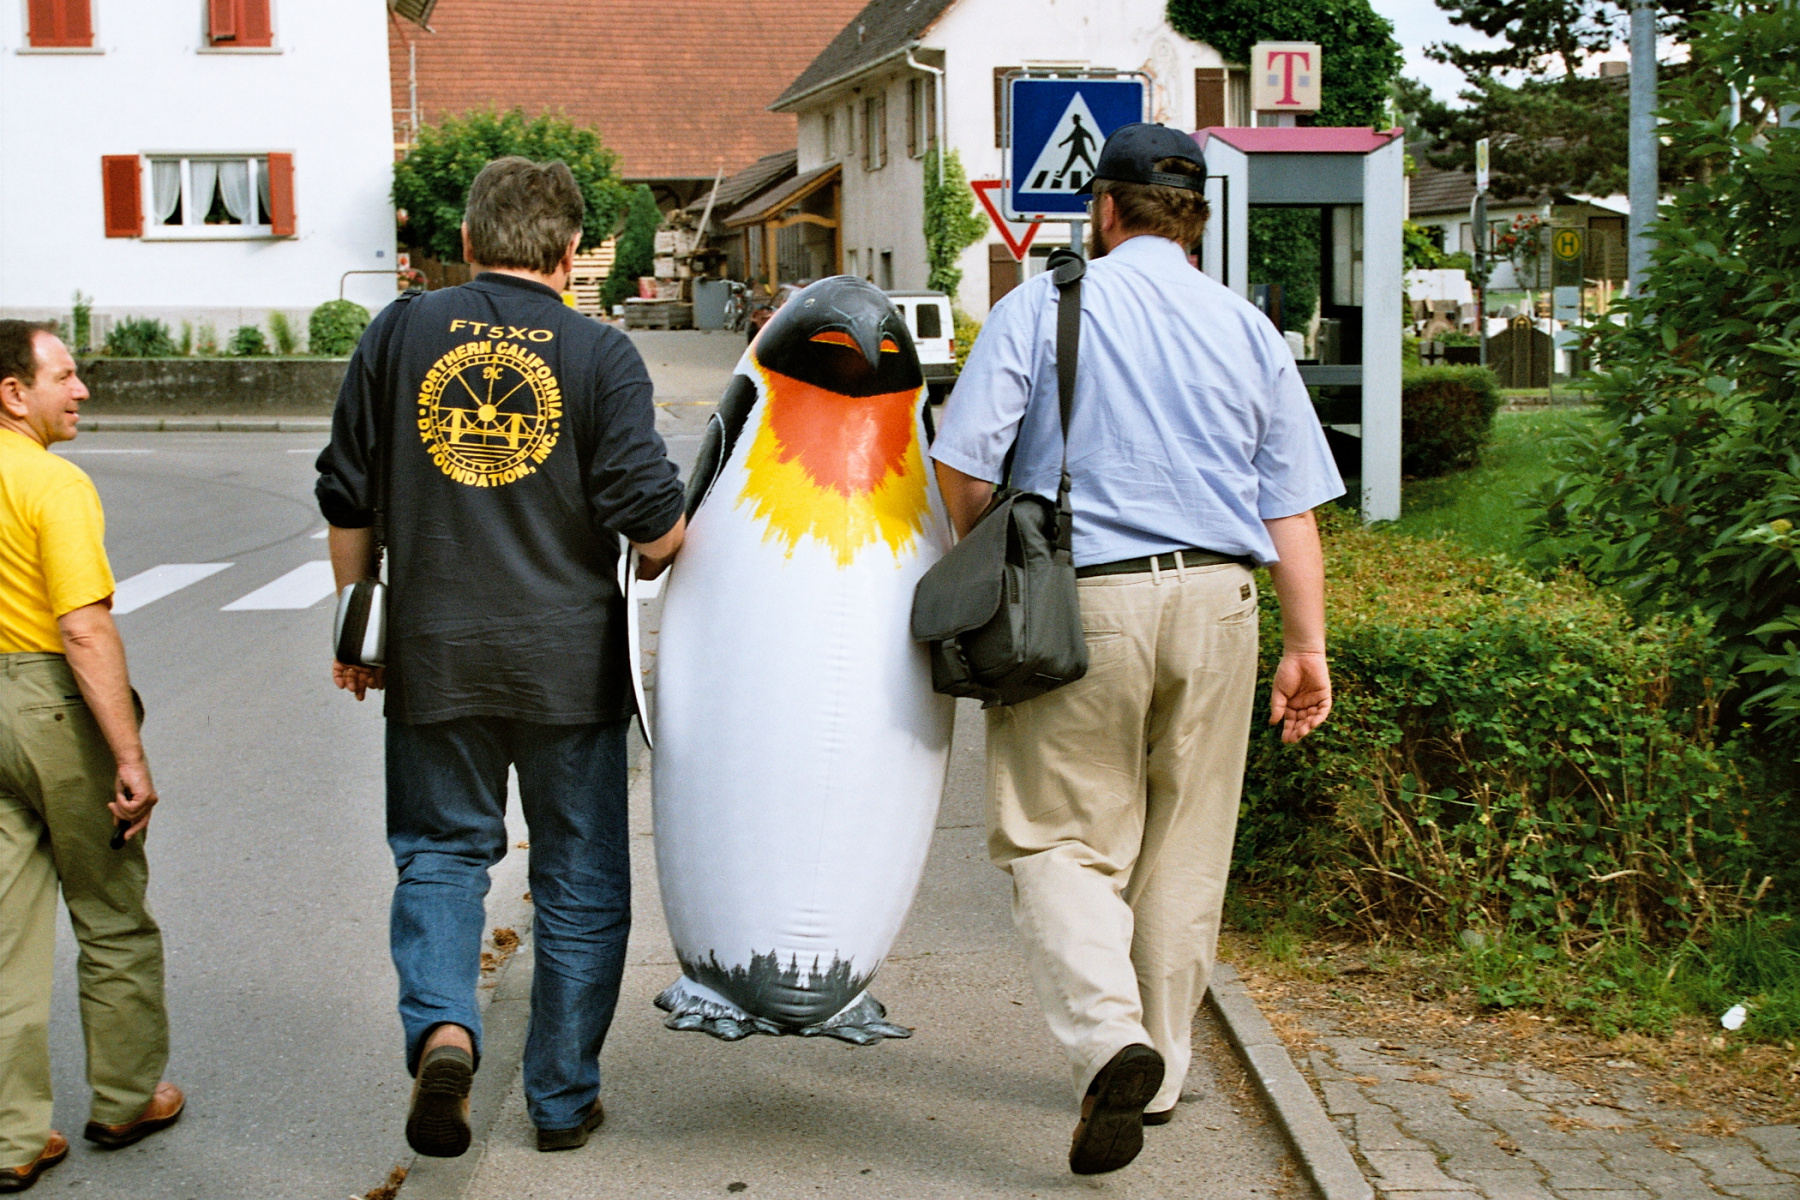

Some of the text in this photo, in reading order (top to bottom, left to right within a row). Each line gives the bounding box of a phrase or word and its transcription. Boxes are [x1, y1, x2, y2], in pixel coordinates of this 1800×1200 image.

[1267, 51, 1310, 105] T
[1561, 235, 1574, 253] H
[450, 319, 554, 342] FT5XO
[417, 340, 563, 420] NORTHERN CALIFORNIA
[417, 419, 560, 487] DX FOUNDATION, INC.
